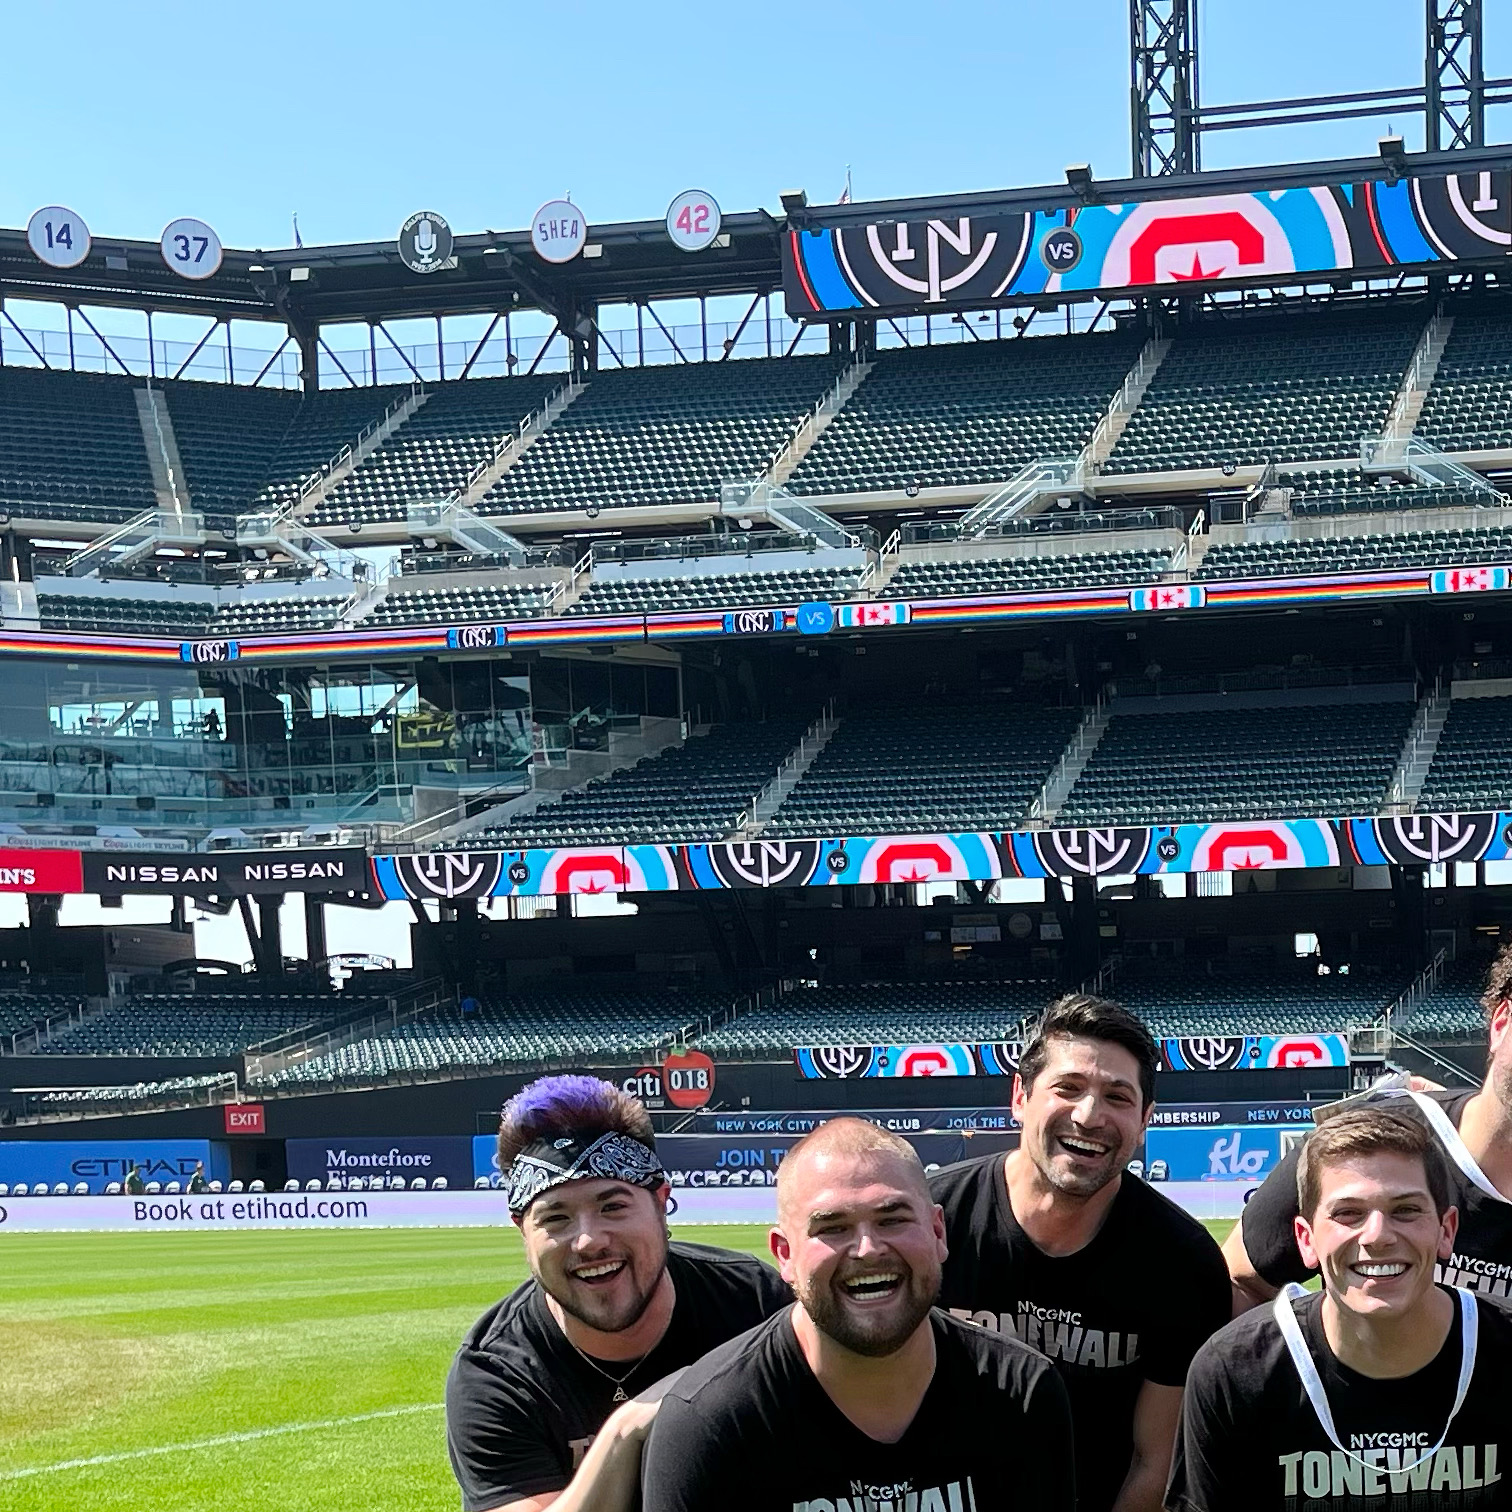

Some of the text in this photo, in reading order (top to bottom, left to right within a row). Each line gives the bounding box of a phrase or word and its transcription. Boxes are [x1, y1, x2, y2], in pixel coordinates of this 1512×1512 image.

[676, 205, 709, 234] 42
[44, 221, 73, 250] 14
[538, 219, 578, 242] SHEA
[173, 234, 209, 263] 37
[1048, 242, 1075, 259] VS
[805, 612, 826, 625] VS
[1159, 843, 1180, 856] VS
[828, 855, 847, 868] VS
[107, 866, 218, 882] NISSAN
[245, 862, 344, 880] NISSAN
[510, 868, 527, 880] VS
[623, 1073, 661, 1097] citi
[670, 1070, 708, 1091] 018
[230, 1112, 260, 1127] EXIT
[947, 1115, 976, 1129] JOIN
[981, 1117, 1006, 1128] THE
[1247, 1107, 1313, 1121] NEW YOR
[716, 1120, 745, 1132] NEW
[749, 1119, 782, 1131] YORK
[787, 1119, 814, 1131] CITY
[888, 1118, 921, 1130] CLUB
[326, 1148, 432, 1167] Montefiore
[716, 1150, 764, 1167] JOIN
[135, 1198, 368, 1221] Book at etihad.com
[1017, 1300, 1082, 1325] NYCGMC
[1350, 1432, 1429, 1448] NYCGMC
[1278, 1443, 1502, 1499] TONEWALL
